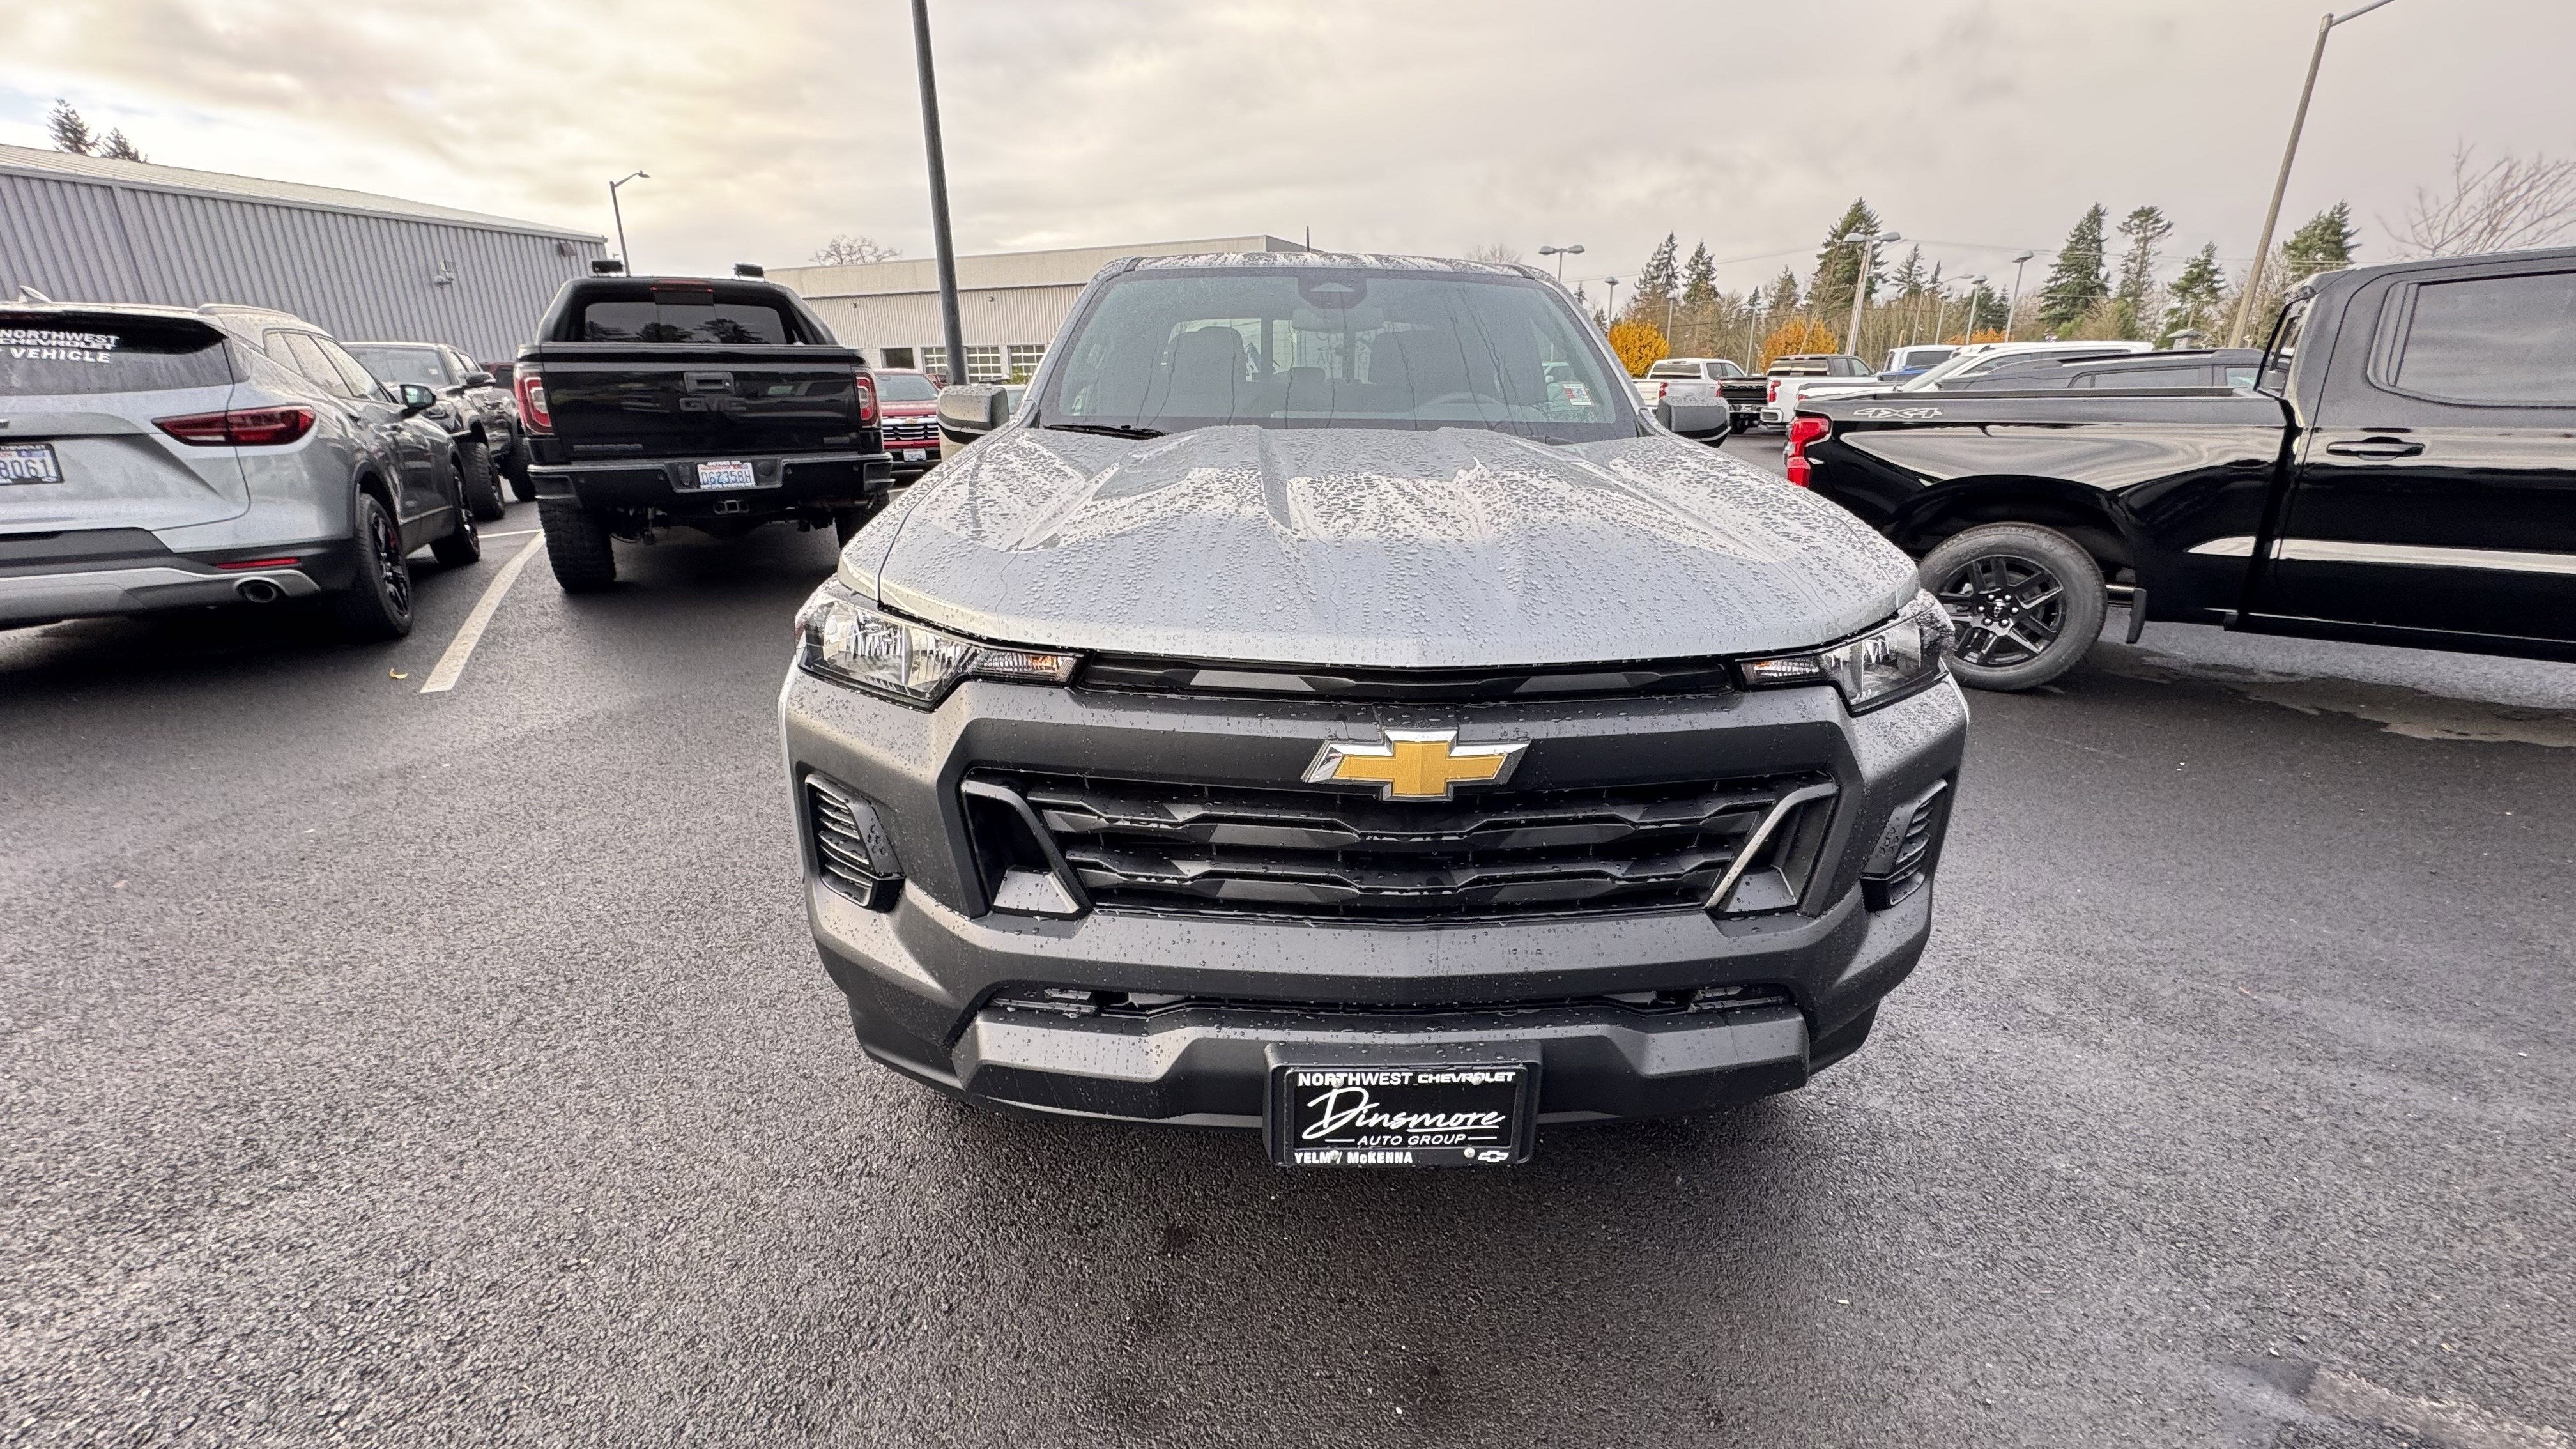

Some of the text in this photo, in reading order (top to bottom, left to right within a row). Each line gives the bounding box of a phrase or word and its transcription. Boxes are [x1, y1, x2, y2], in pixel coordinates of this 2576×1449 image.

[0, 329, 119, 344] NORTHWEST
[10, 348, 111, 363] VEHICLE
[1298, 1072, 1516, 1087] NORTHWEST CHEVROLET
[1301, 1087, 1506, 1140] Dinsmore
[1357, 1134, 1466, 1146] AUTO GROUP
[1347, 1152, 1413, 1163] McKENNA
